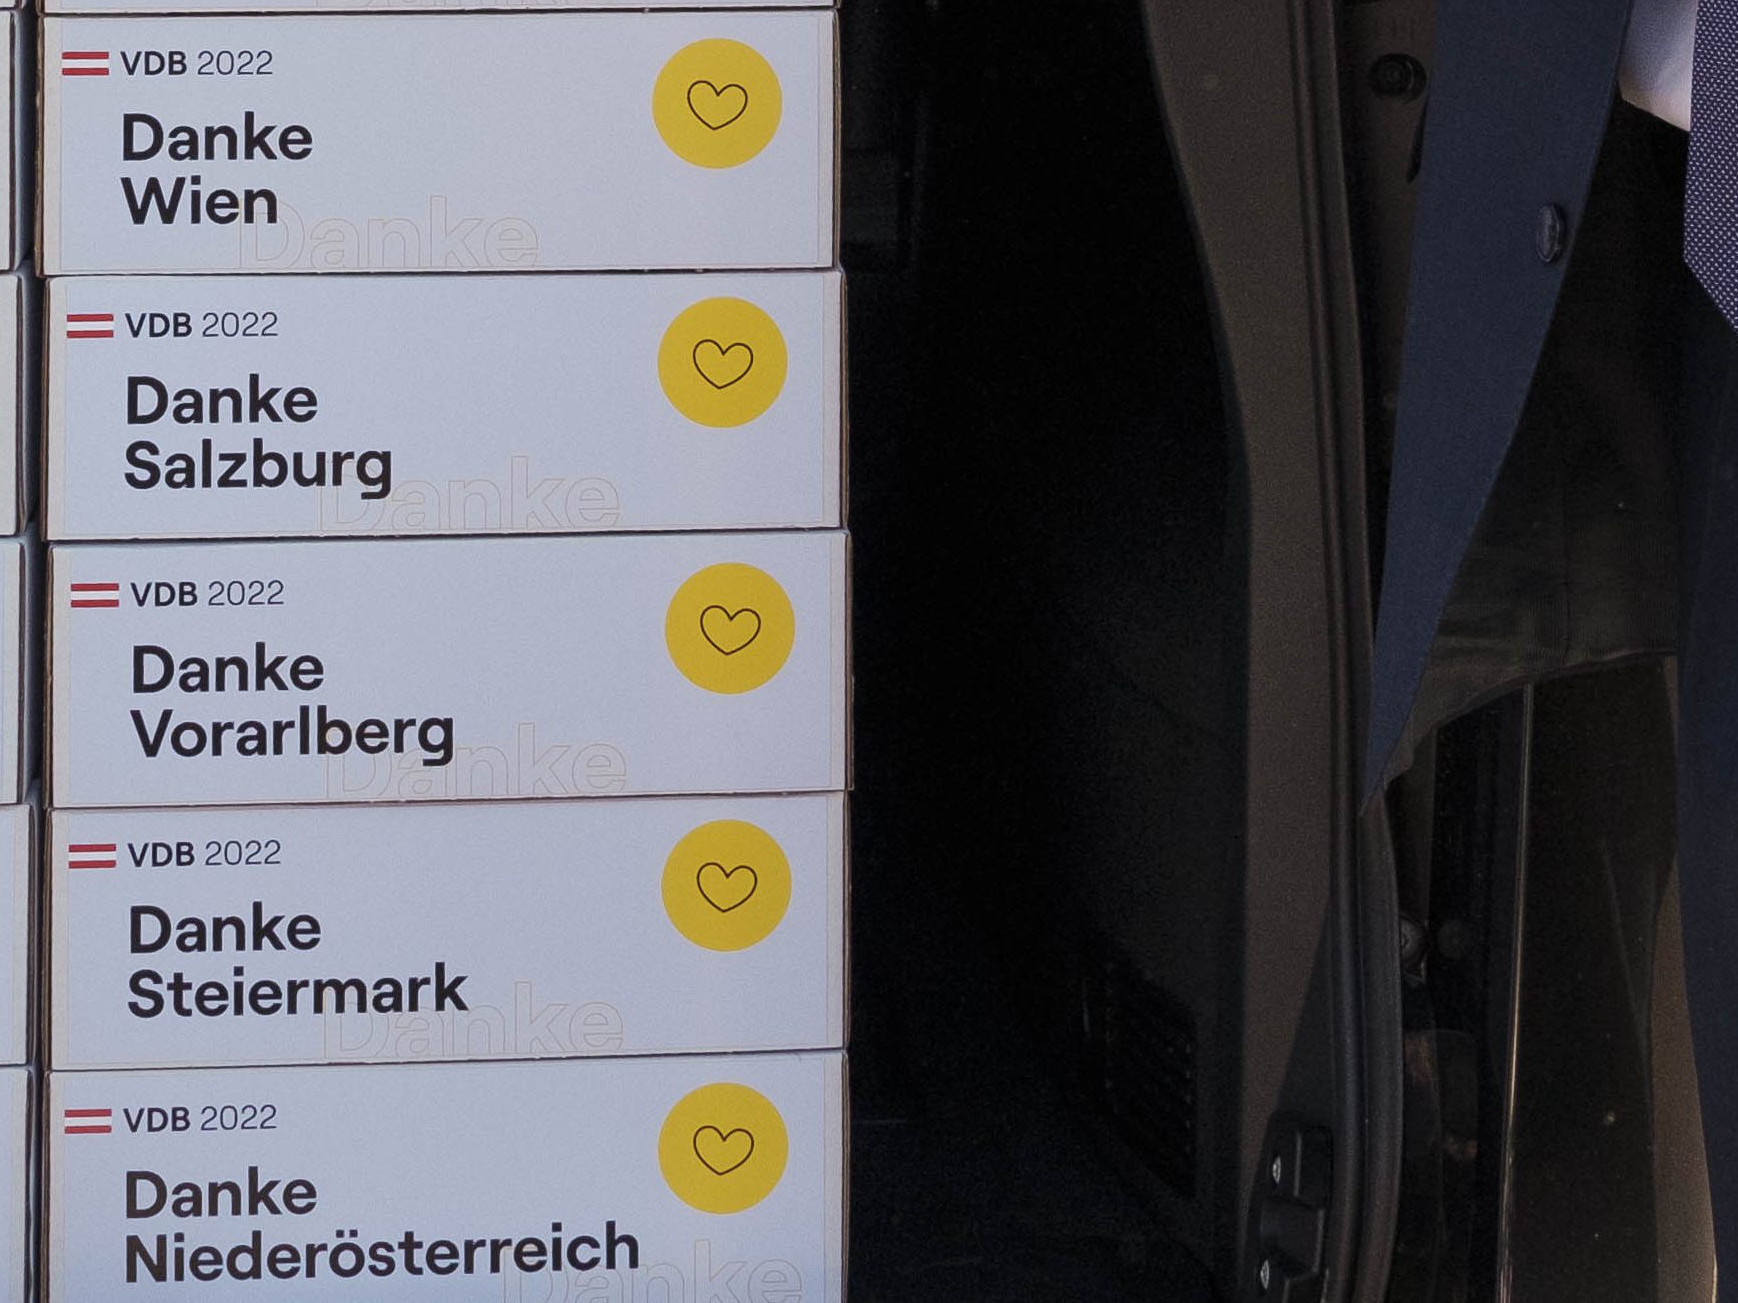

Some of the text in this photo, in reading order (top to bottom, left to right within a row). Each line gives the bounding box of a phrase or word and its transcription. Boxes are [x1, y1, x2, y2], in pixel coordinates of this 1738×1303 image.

[120, 50, 272, 75] VDB 2022
[123, 111, 312, 161] Danke
[121, 175, 277, 224] Wien
[125, 312, 278, 338] VDB 2022
[128, 374, 317, 424] Danke
[125, 438, 391, 499] Salzburg
[131, 580, 284, 607] VDB 2022
[133, 642, 323, 693] Danke
[130, 705, 453, 766] Vorarlberg
[128, 840, 280, 867] VDB 2022
[131, 901, 321, 953] Danke
[128, 962, 469, 1018] Steiermark
[123, 1105, 276, 1132] VDB 2022
[126, 1166, 316, 1218] Danke
[126, 1221, 638, 1283] Niederösterreich
